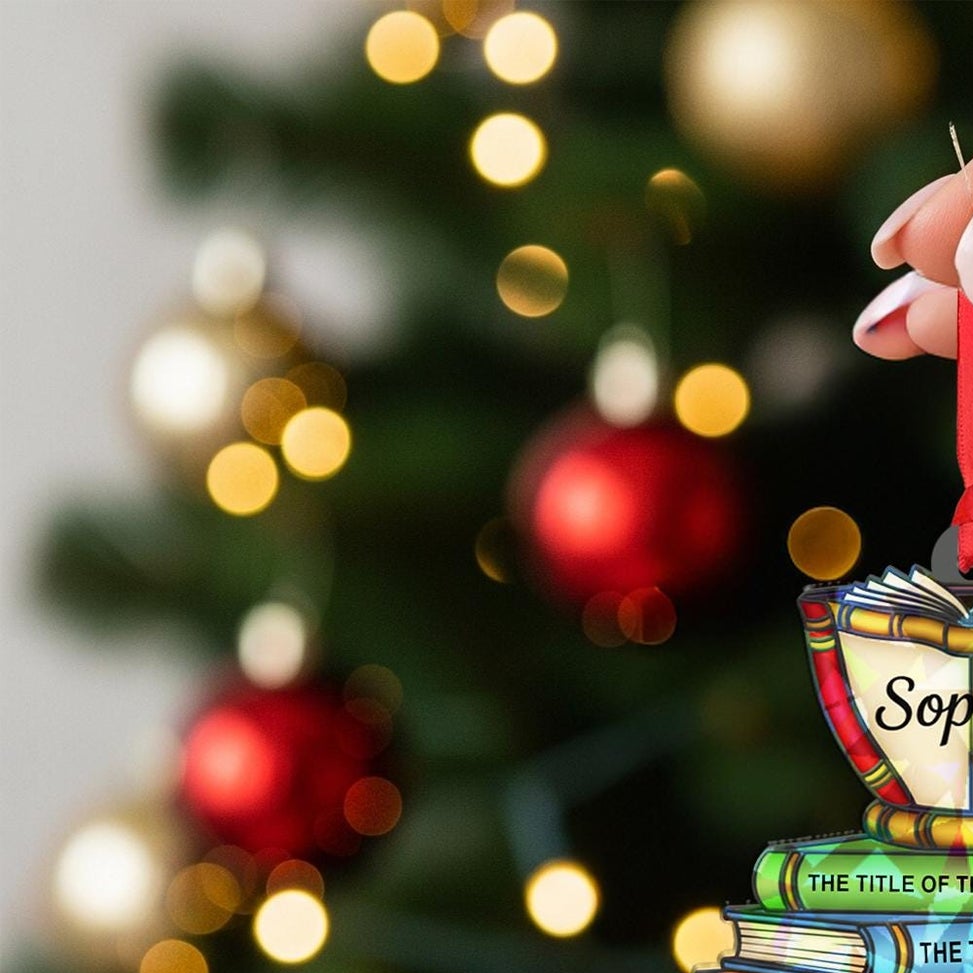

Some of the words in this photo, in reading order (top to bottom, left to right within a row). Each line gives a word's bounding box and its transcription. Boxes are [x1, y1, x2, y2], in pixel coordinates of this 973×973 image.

[808, 874, 849, 892] THE
[855, 874, 914, 893] TITLE
[921, 875, 950, 893] OF
[919, 941, 962, 964] THE
